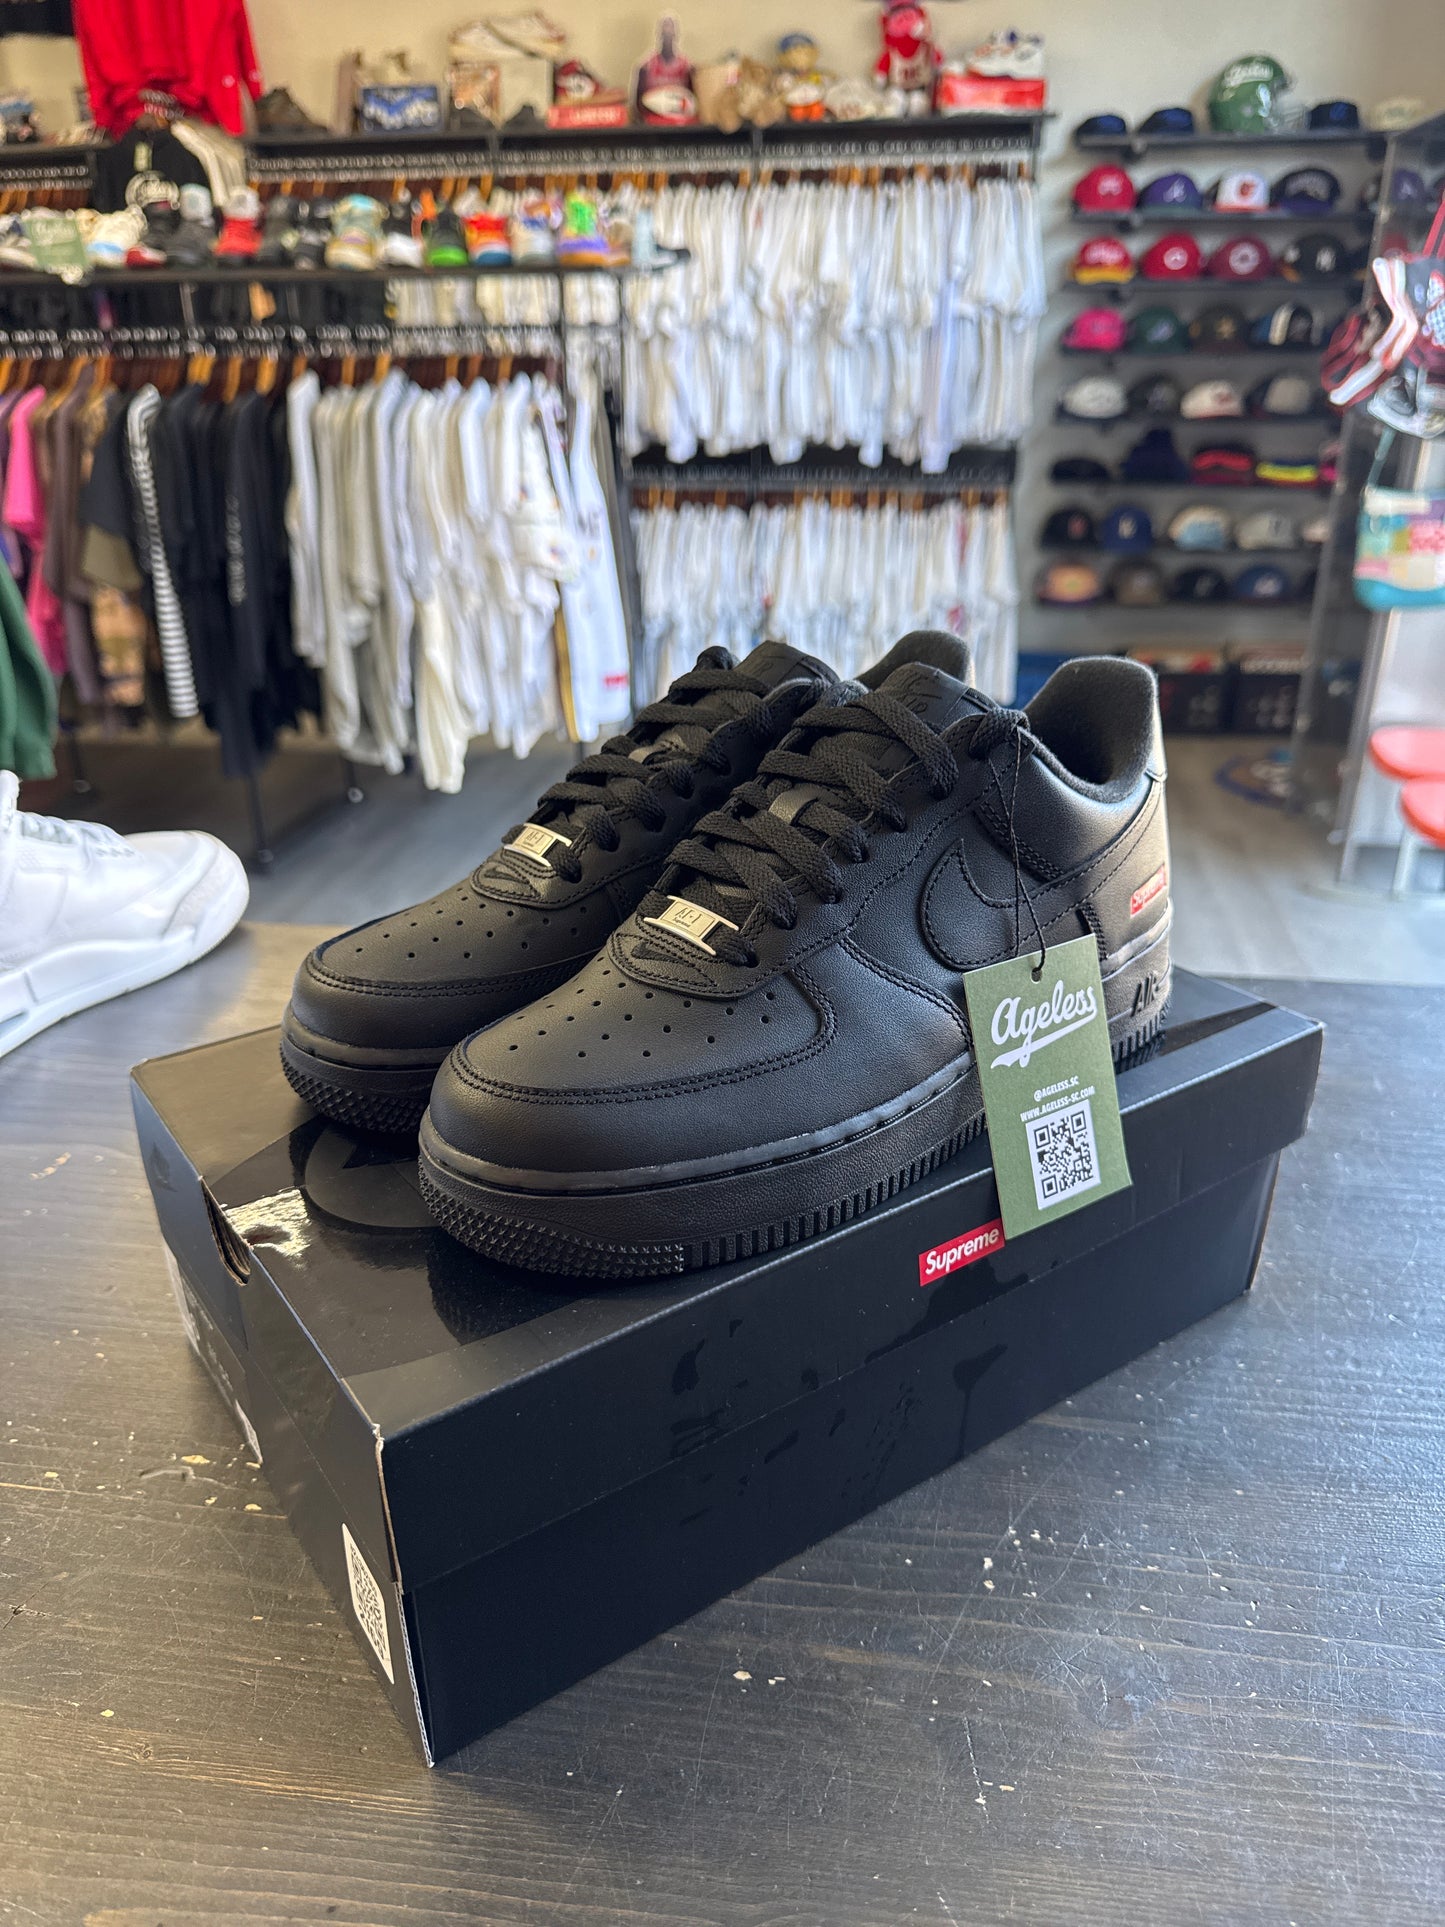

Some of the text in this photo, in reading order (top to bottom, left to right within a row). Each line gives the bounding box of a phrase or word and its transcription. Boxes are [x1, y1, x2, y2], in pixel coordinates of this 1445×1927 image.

[1130, 972, 1159, 1017] AIR
[991, 980, 1097, 1069] Ageless
[1020, 1085, 1096, 1122] WWW.AGELESS-SC.COM
[1034, 1075, 1079, 1102] @AGELESS.SC
[925, 1228, 1000, 1275] Supreme
